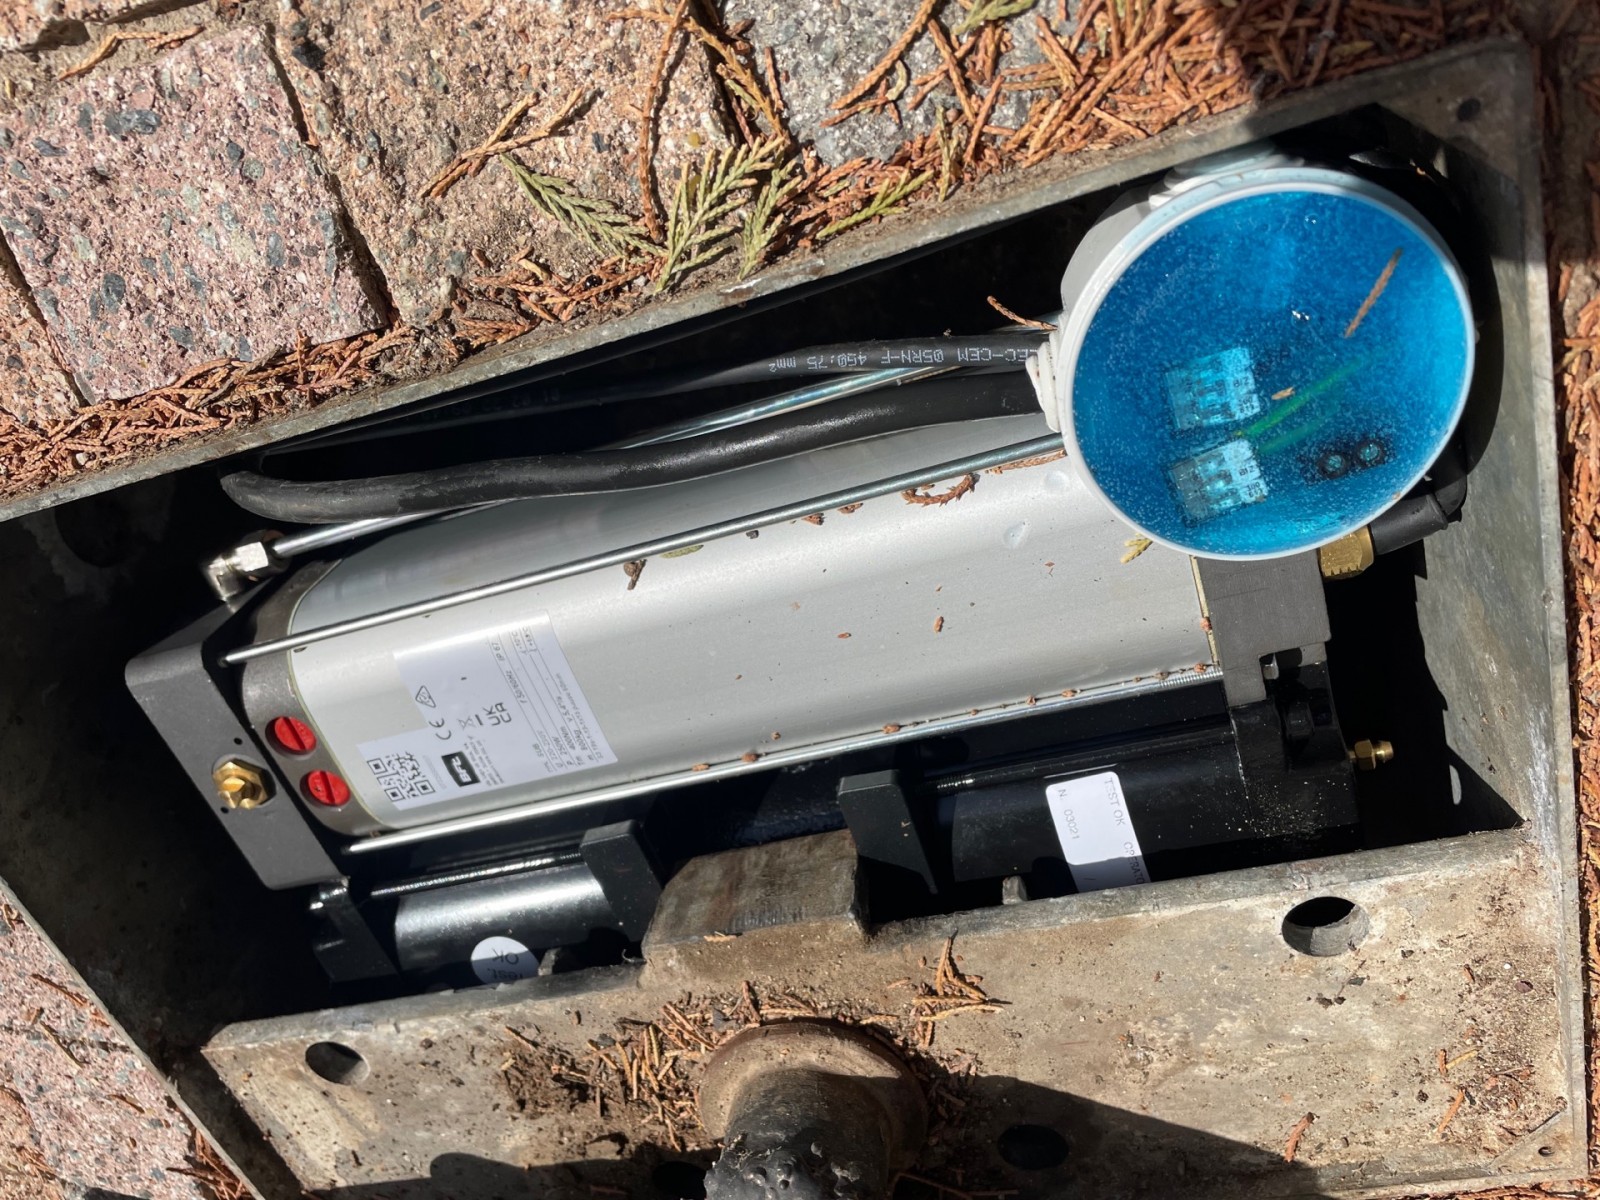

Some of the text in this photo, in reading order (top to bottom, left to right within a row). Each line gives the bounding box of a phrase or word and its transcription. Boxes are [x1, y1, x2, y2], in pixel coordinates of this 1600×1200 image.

[957, 347, 1038, 361] EC-CEM
[482, 705, 501, 726] UK
[494, 702, 512, 723] CA
[1113, 809, 1127, 826] OK
[491, 947, 519, 965] OK
